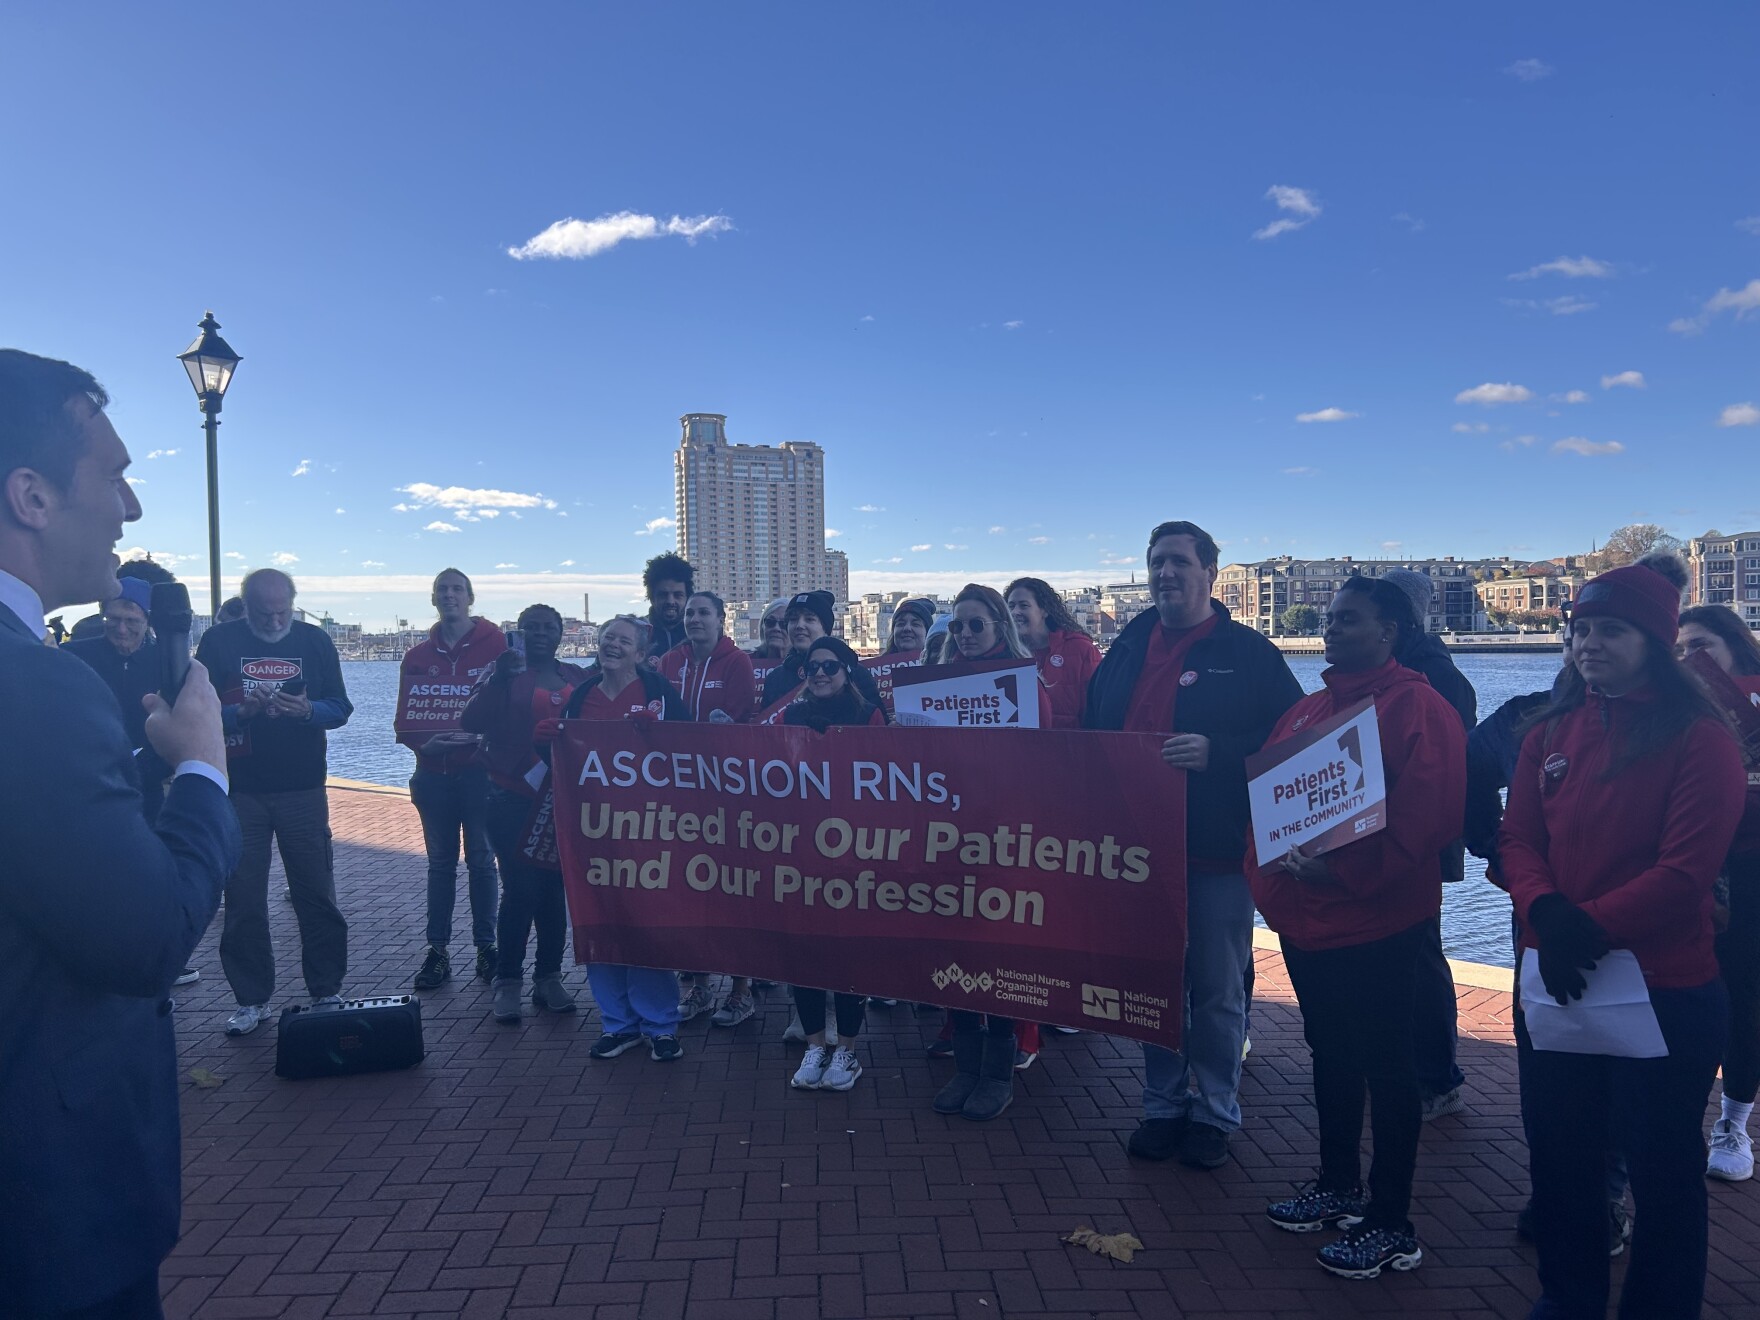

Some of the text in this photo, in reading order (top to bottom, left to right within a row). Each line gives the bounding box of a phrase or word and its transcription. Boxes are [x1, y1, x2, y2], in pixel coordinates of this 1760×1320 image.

[248, 665, 296, 675] DANGER
[409, 684, 471, 696] ASCENS
[407, 698, 467, 709] Put Patie
[921, 694, 1000, 711] Patients
[405, 710, 450, 721] Before
[957, 709, 1001, 725] First
[578, 750, 960, 811] ASCENSION RNs,
[1273, 760, 1346, 804] Patients
[1307, 778, 1349, 811] First
[1269, 828, 1281, 842] IN
[1281, 820, 1302, 837] THE
[1304, 791, 1365, 828] COMMUNITY
[580, 801, 1151, 883] United for Our Patients
[586, 850, 671, 890] and
[685, 853, 761, 897] Our
[774, 864, 1044, 926] Profession
[996, 967, 1071, 989] National Nurses
[996, 979, 1049, 997] Organizing
[995, 989, 1049, 1007] Committee
[1124, 990, 1168, 1009] National
[1124, 1002, 1161, 1018] Nurses
[1125, 1013, 1160, 1030] United
